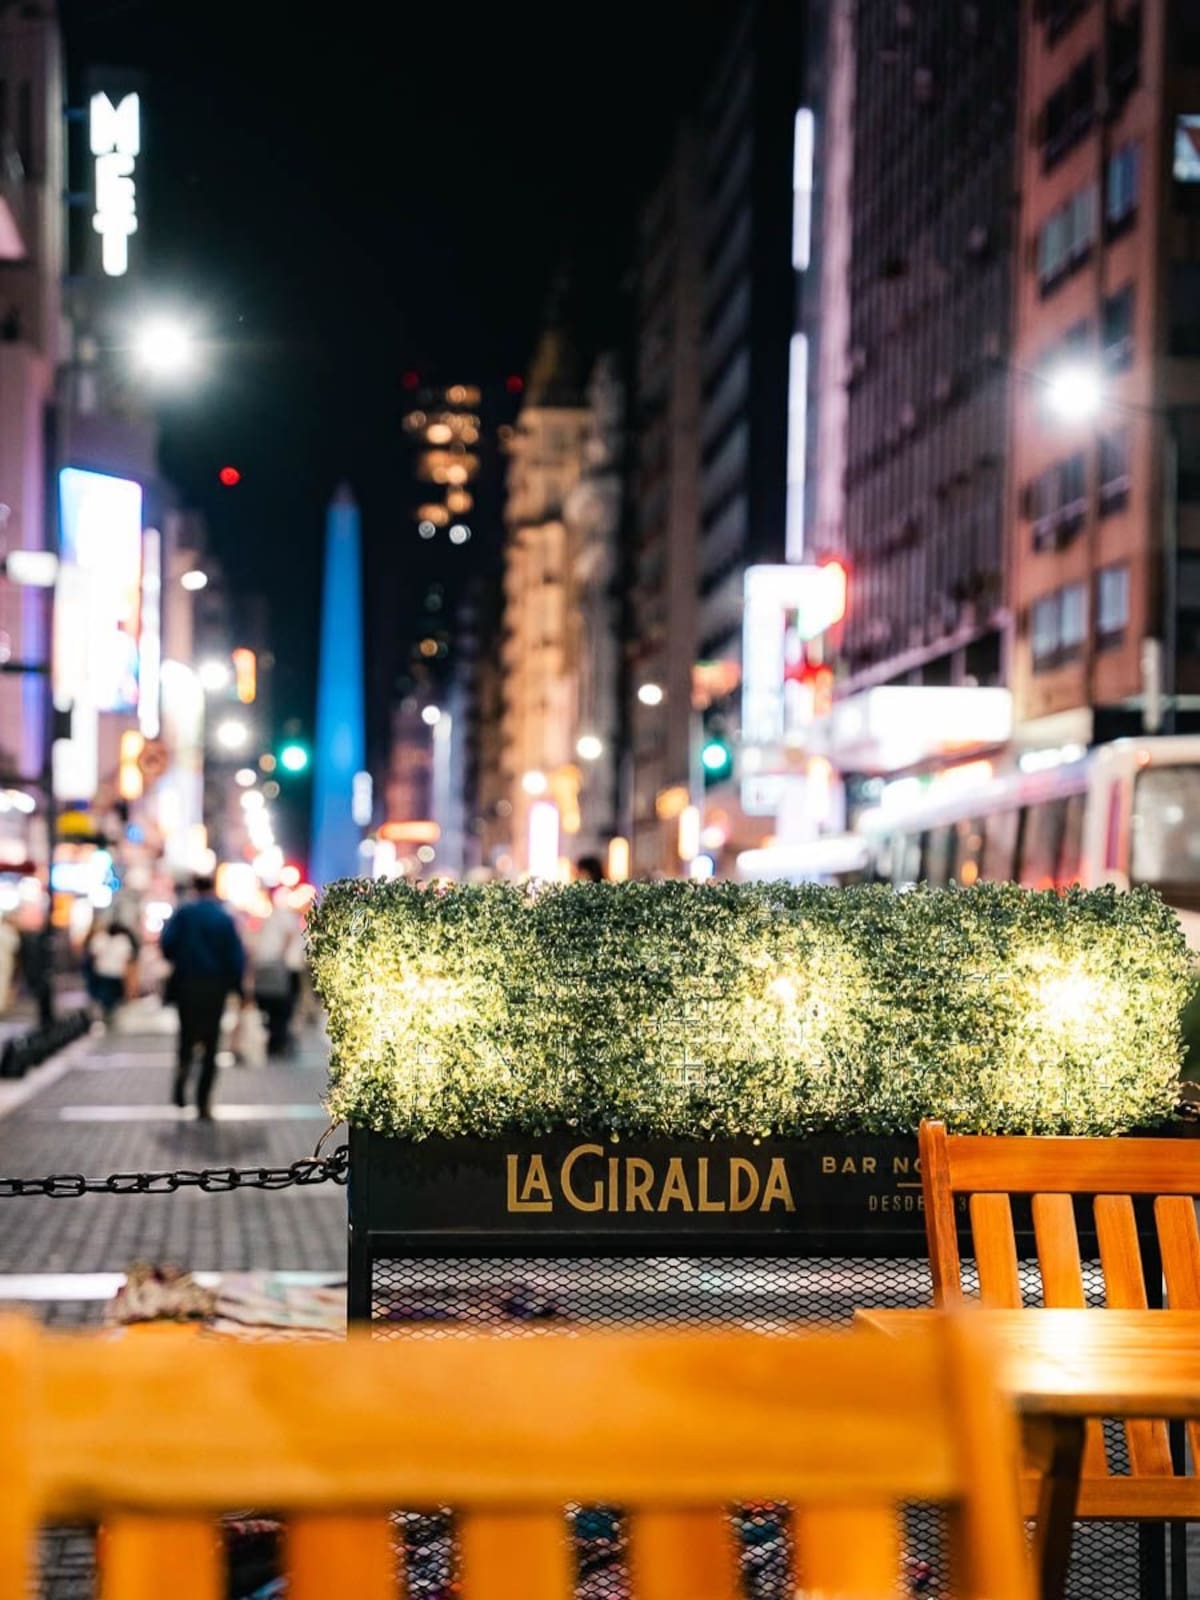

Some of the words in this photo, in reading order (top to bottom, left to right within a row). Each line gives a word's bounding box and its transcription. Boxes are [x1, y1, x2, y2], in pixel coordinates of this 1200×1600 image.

[822, 1156, 877, 1173] BAR
[506, 1154, 553, 1212] LA
[560, 1143, 796, 1212] GIRALDA
[868, 1195, 925, 1211] DESDE
